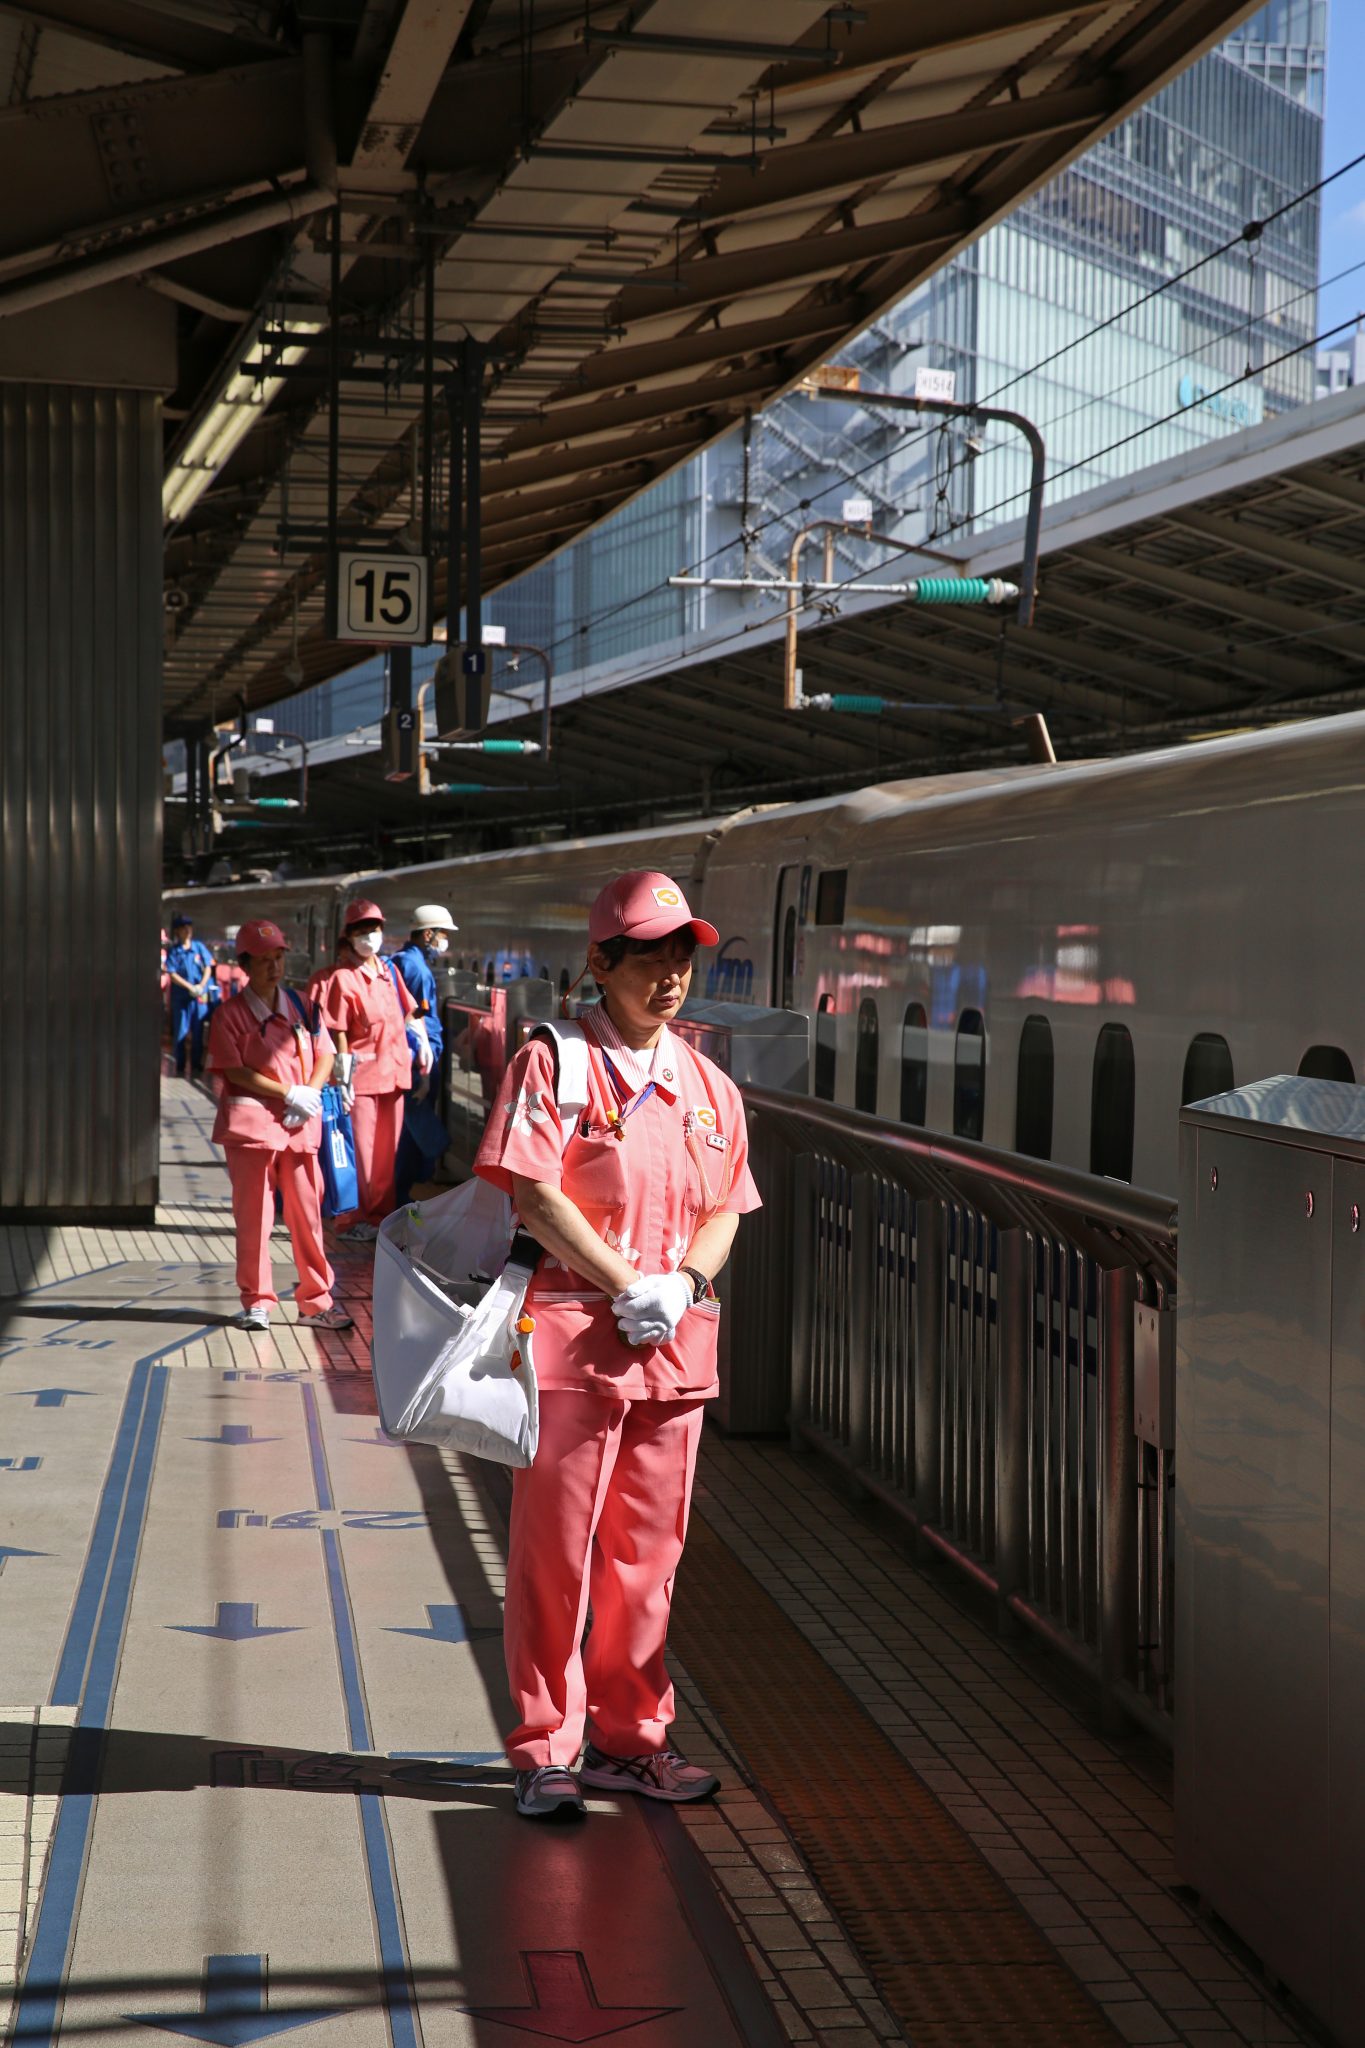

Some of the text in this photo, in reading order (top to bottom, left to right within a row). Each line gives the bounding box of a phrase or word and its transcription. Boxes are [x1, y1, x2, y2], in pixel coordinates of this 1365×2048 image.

[355, 570, 412, 625] 15
[468, 654, 478, 672] 1
[401, 715, 412, 728] 2
